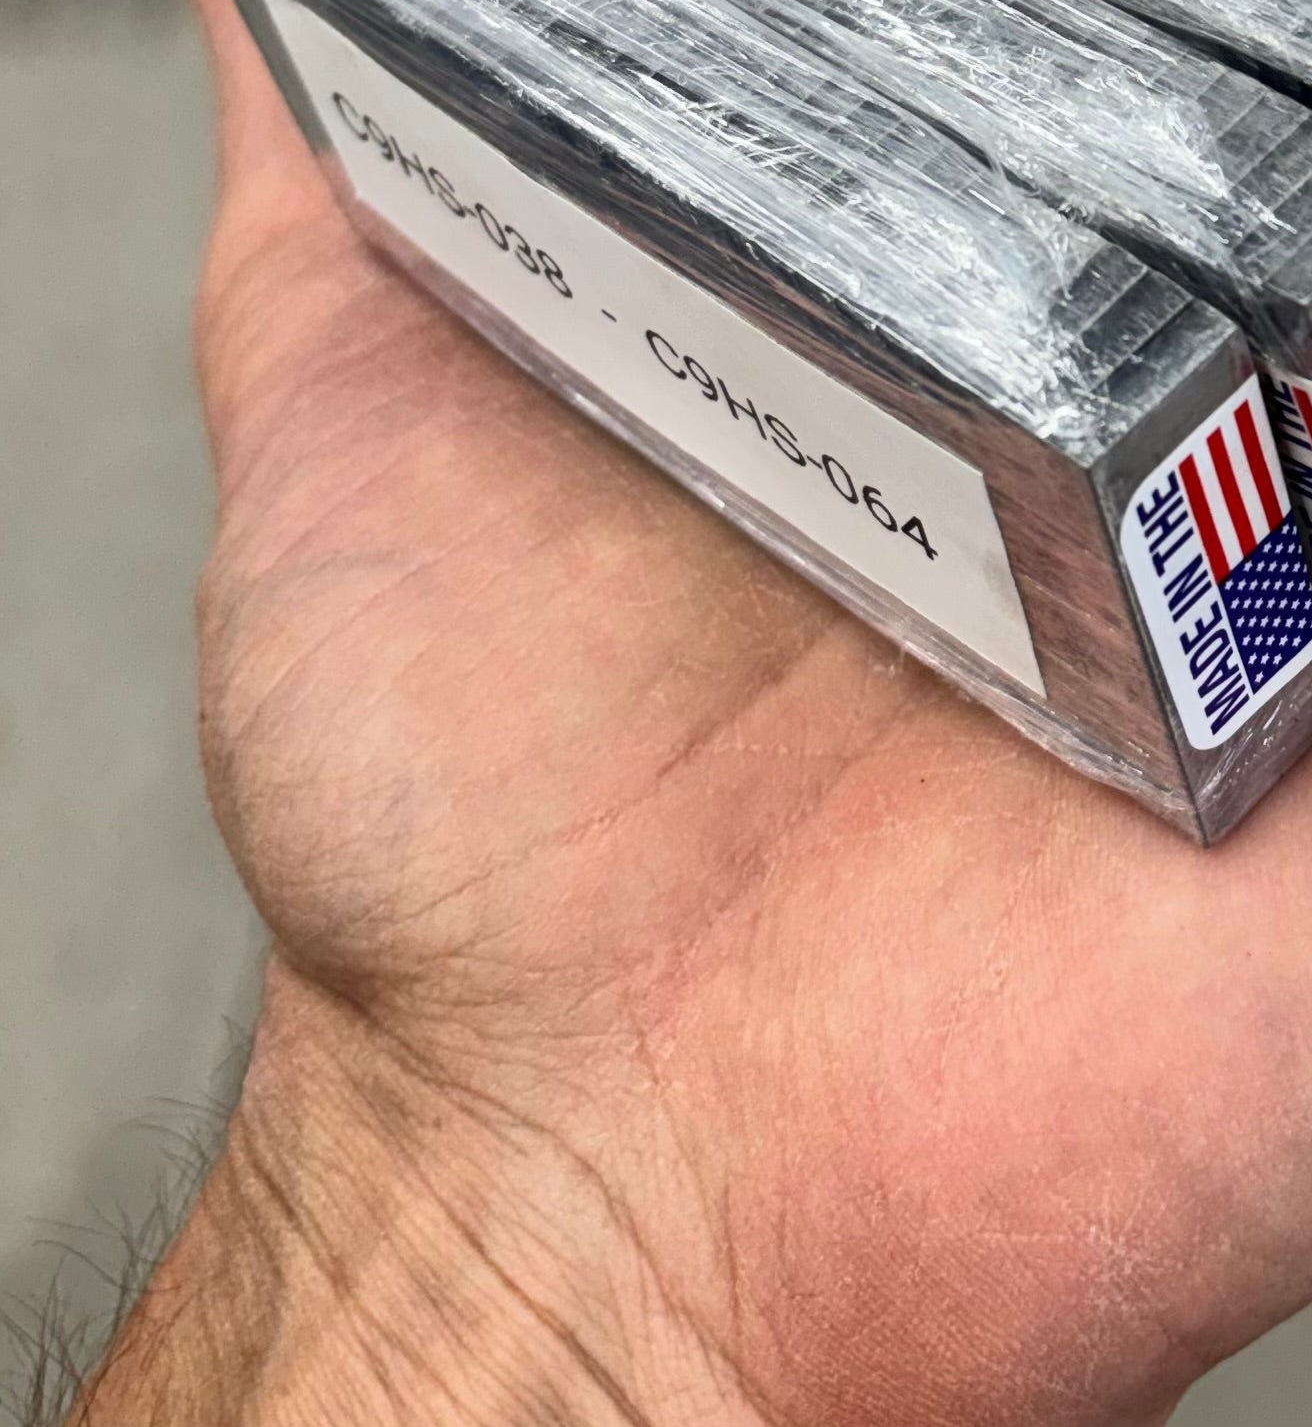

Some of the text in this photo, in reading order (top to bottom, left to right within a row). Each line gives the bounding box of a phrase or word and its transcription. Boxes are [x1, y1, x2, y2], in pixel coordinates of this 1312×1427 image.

[331, 90, 940, 561] C9HS-038 - C9HS-064
[1135, 470, 1252, 736] MADE IN THE
